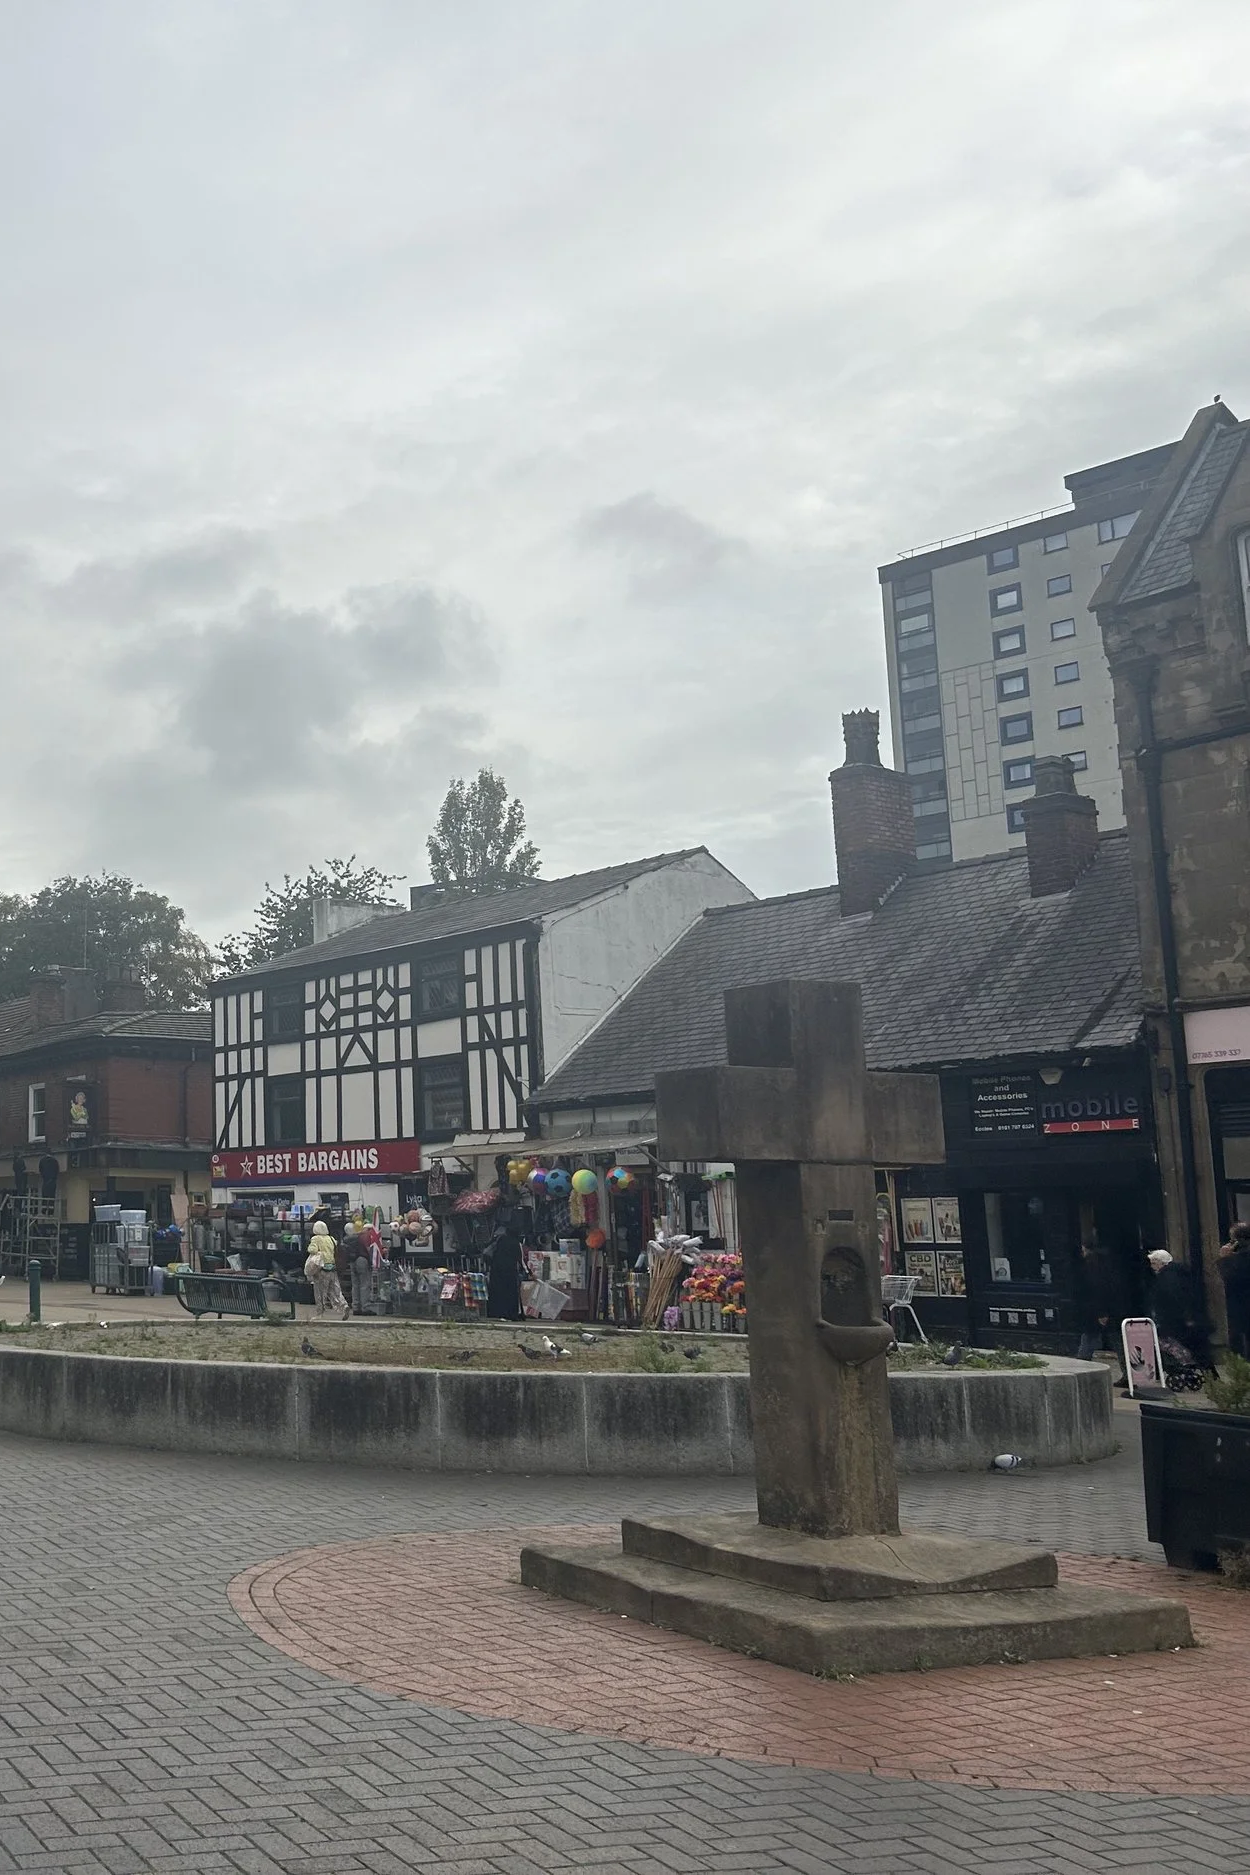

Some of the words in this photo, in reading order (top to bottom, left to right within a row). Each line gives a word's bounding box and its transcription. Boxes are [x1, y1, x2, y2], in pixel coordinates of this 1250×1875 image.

[972, 1077, 998, 1085] Mobile
[1000, 1075, 1031, 1083] Phones
[977, 1092, 1028, 1101] Accessories
[1041, 1093, 1138, 1118] mobile
[257, 1153, 292, 1174] BEST
[298, 1148, 379, 1172] BARGAINS
[909, 1254, 932, 1263] CBD
